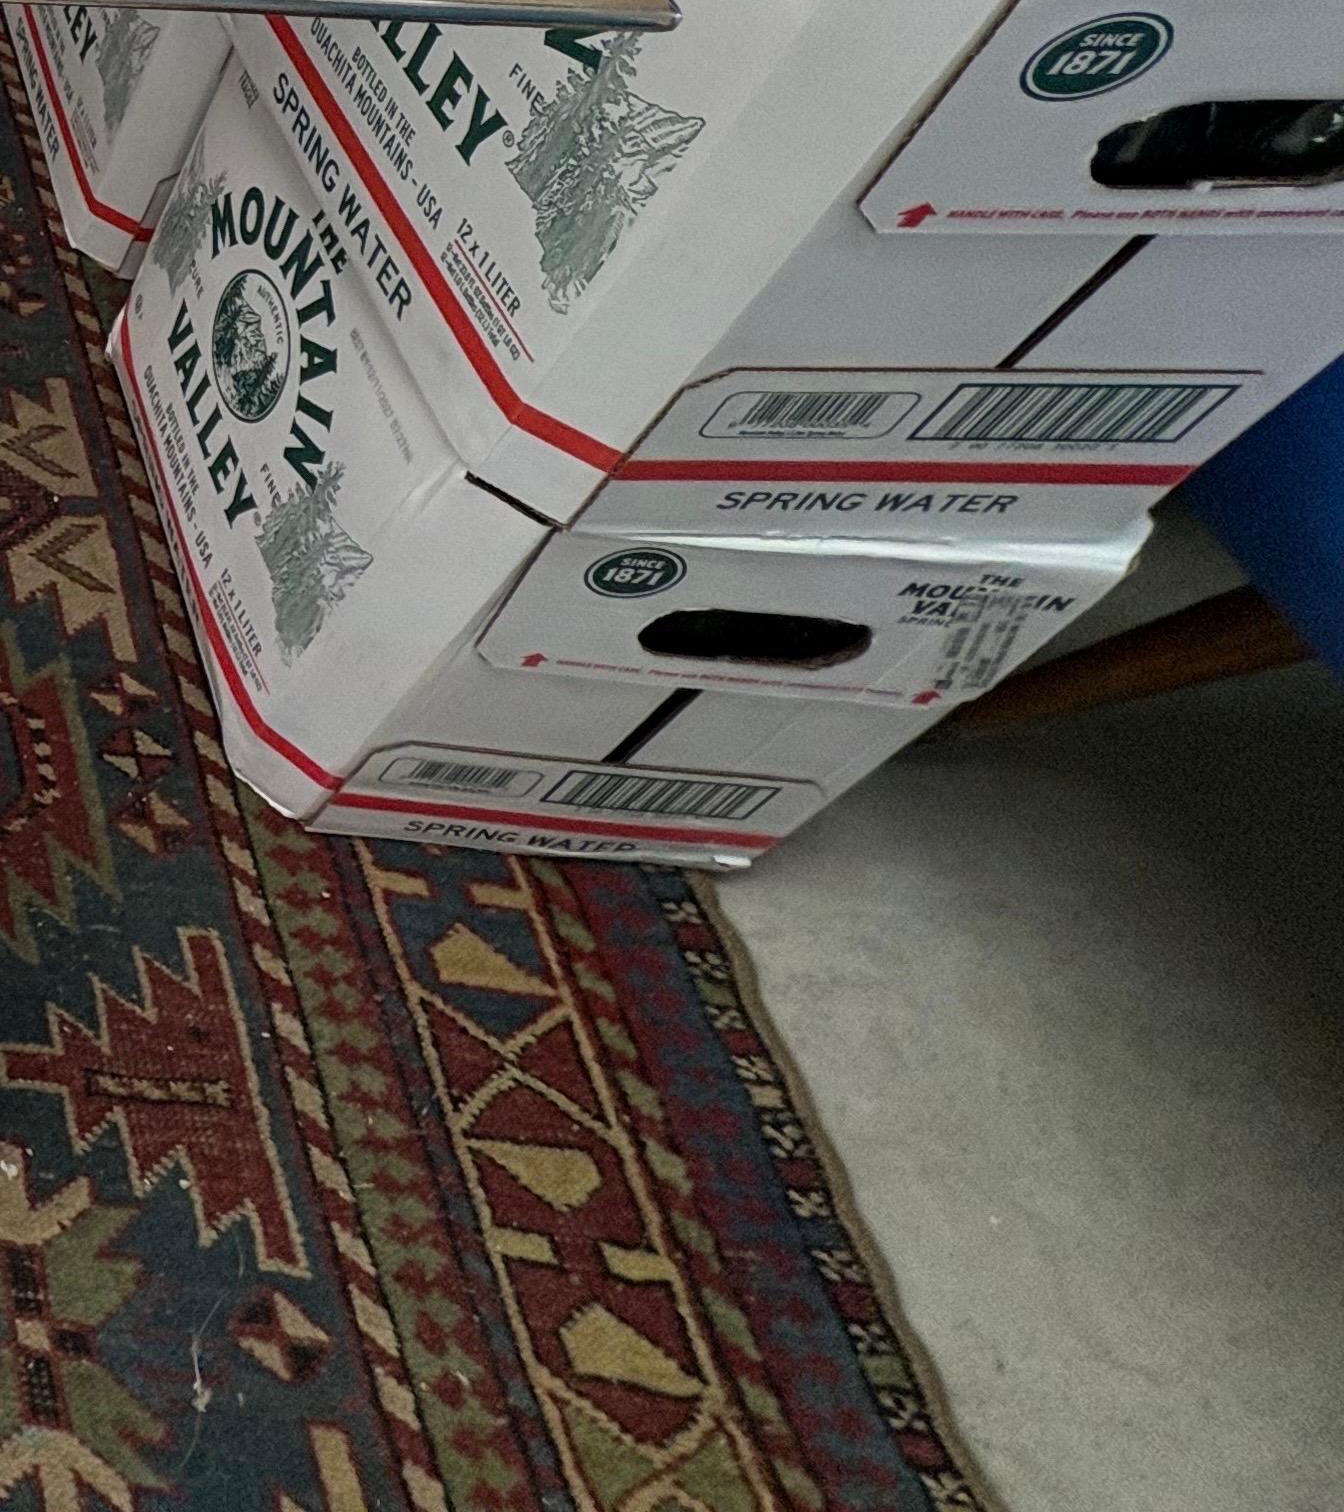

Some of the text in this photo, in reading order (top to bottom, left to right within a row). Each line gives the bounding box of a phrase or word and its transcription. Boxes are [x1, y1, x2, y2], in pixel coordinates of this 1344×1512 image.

[1046, 49, 1137, 75] 1871
[1079, 33, 1145, 47] SINCE
[16, 17, 60, 162] SPRING WATER
[310, 16, 444, 231] OUACHITA MOUNTAINS USA
[351, 46, 416, 147] BOTTLED IN THE
[371, 17, 508, 167] LLEY
[509, 63, 545, 110] FINE
[273, 71, 341, 193] SPRING
[336, 184, 413, 321] WATER
[457, 218, 473, 242] 12
[483, 260, 522, 318] LITER
[210, 186, 338, 495] MOUNTAIN
[165, 402, 186, 454] BOTTLED
[187, 468, 200, 496] THE
[167, 297, 258, 530] VALLEY
[143, 364, 213, 569] OUACHITA MOUNTAINS USA
[260, 462, 282, 508] FINE
[716, 492, 1021, 514] SPRING WATER
[602, 568, 666, 587] 1871
[619, 557, 669, 571] SINCE
[979, 574, 1027, 587] THE
[219, 567, 262, 658] 12 LITER
[403, 820, 639, 853] SPRING WATER
